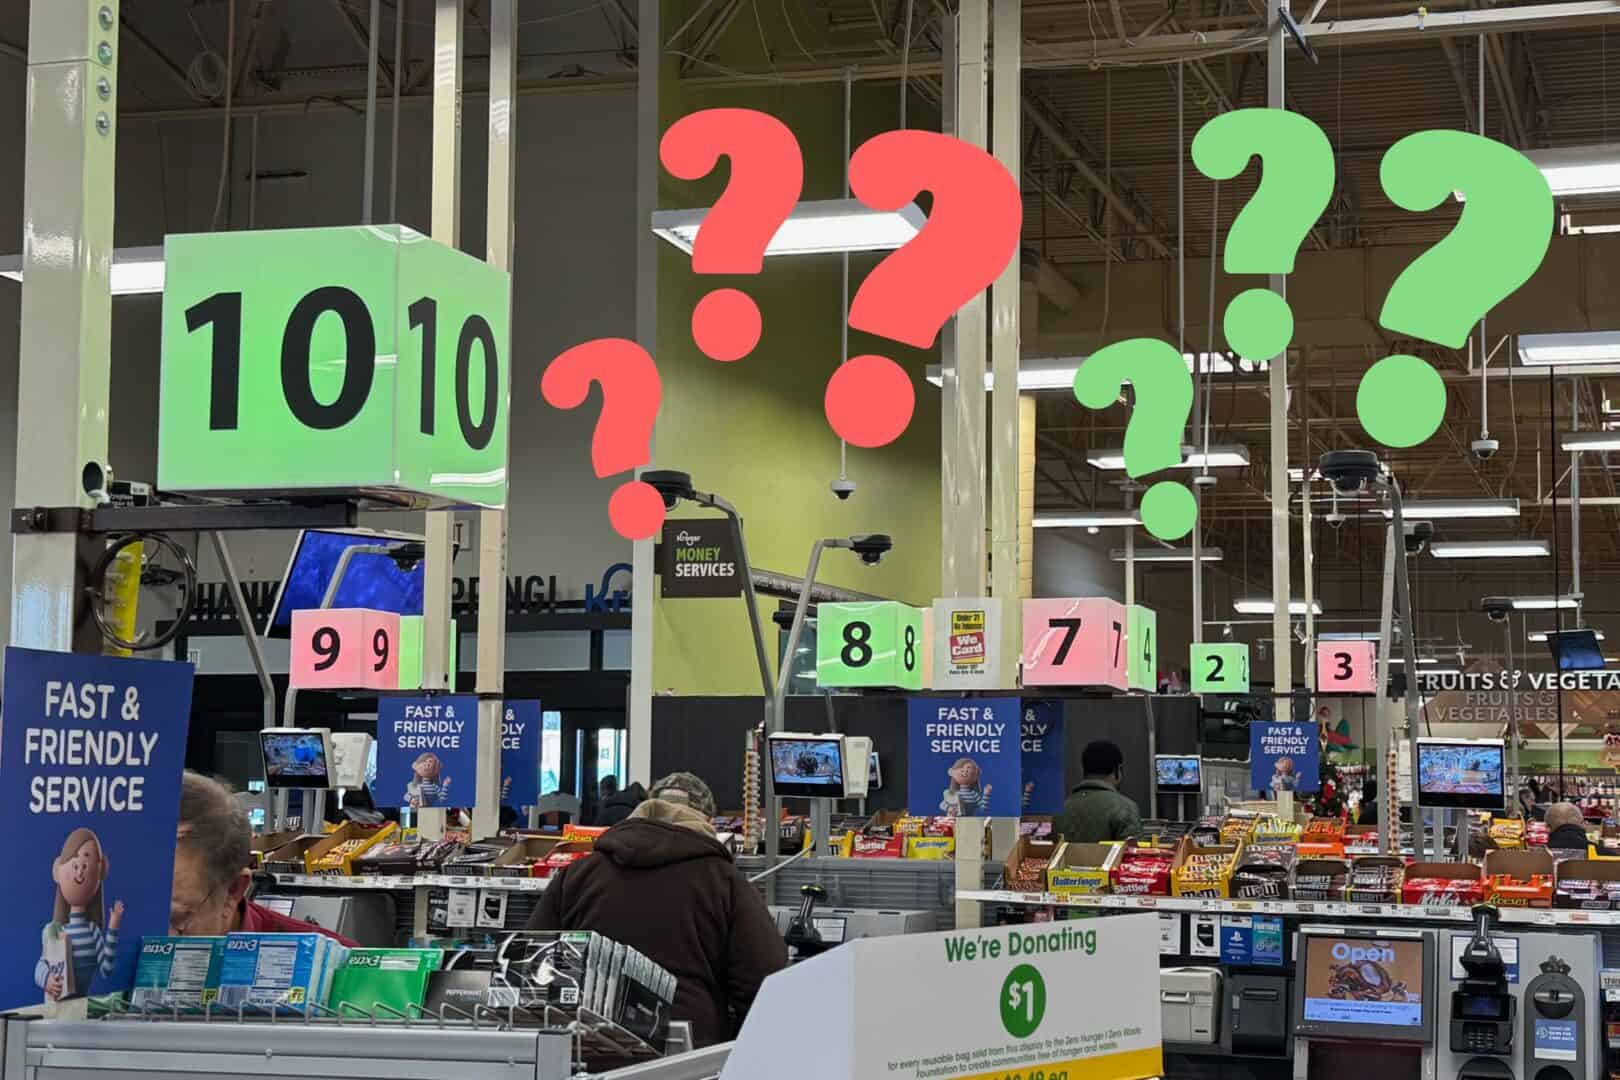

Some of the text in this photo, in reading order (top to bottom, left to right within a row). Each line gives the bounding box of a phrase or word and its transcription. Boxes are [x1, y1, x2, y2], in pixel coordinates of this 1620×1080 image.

[184, 286, 376, 431] 10
[408, 296, 499, 451] 10
[676, 547, 720, 561] MONEY
[675, 562, 735, 577] SERVICES
[312, 627, 341, 671] 9
[373, 628, 389, 672] 9
[841, 621, 873, 668] 8
[904, 625, 915, 672] 8
[1048, 618, 1082, 666] 7
[1143, 627, 1151, 673] 4
[1206, 655, 1225, 682] 2
[1334, 652, 1353, 680] 3
[45, 681, 140, 720] FAST &
[1466, 692, 1534, 706] FRUITS
[405, 705, 455, 719] FAST &
[505, 709, 515, 721] &
[938, 707, 993, 721] FAST &
[1025, 709, 1035, 721] &
[1435, 706, 1559, 721] VEGETABLES
[394, 720, 465, 733] FRIENDLY
[926, 723, 1005, 737] FRIENDLY
[1268, 728, 1292, 736] FAST
[25, 728, 159, 766] FRIENDLY
[398, 736, 460, 748] SERVICE
[931, 739, 1000, 753] SERVICE
[1261, 736, 1309, 746] FRIENDLY
[1264, 746, 1306, 755] SERVICE
[29, 775, 145, 813] SERVICE
[944, 927, 1097, 962] We're Donating
[1331, 942, 1396, 964] Open
[1008, 980, 1034, 1022] $1
